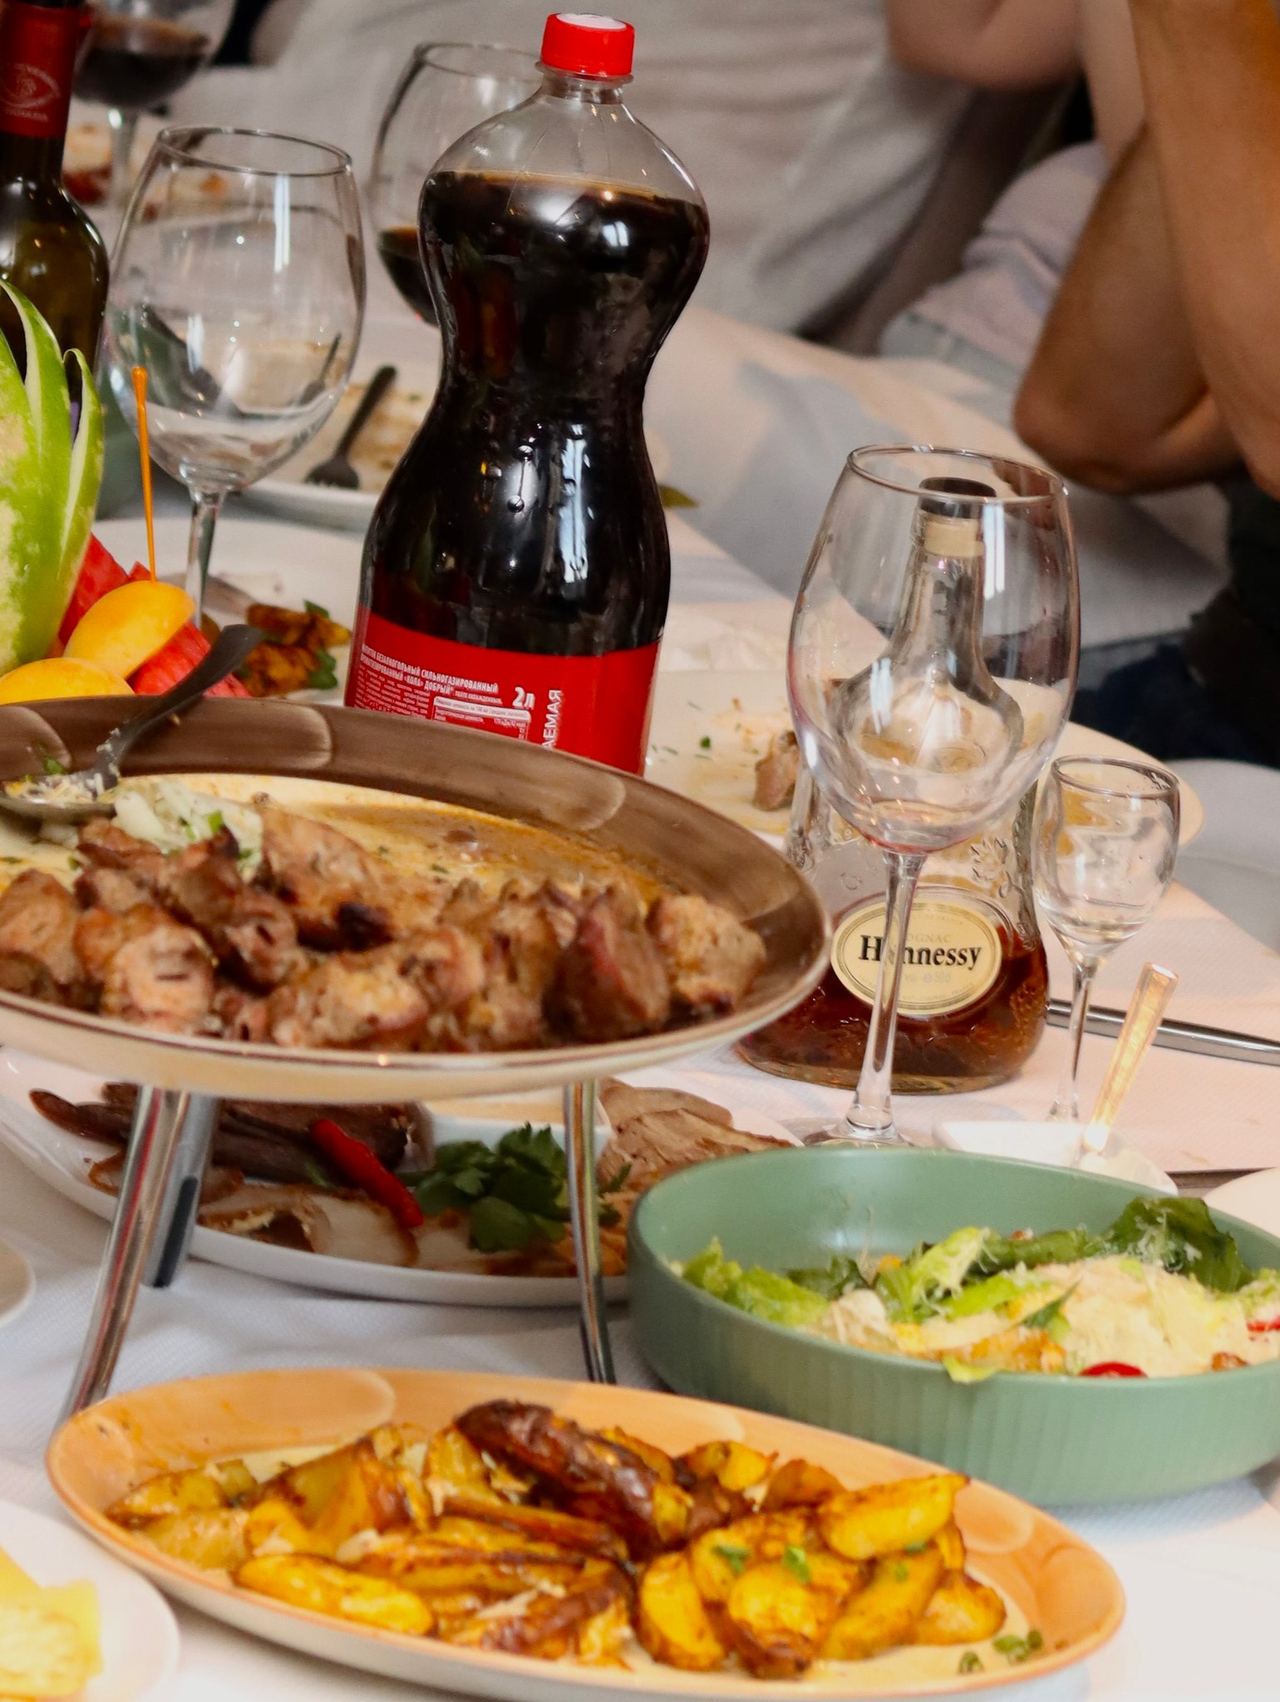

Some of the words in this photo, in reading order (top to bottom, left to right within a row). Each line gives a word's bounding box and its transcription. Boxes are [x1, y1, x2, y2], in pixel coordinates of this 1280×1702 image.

[421, 669, 499, 694] СИЛЬНОГАЗИРОВАННЫЙ
[906, 932, 952, 944] OGNAC
[858, 935, 982, 971] Hnnessy
